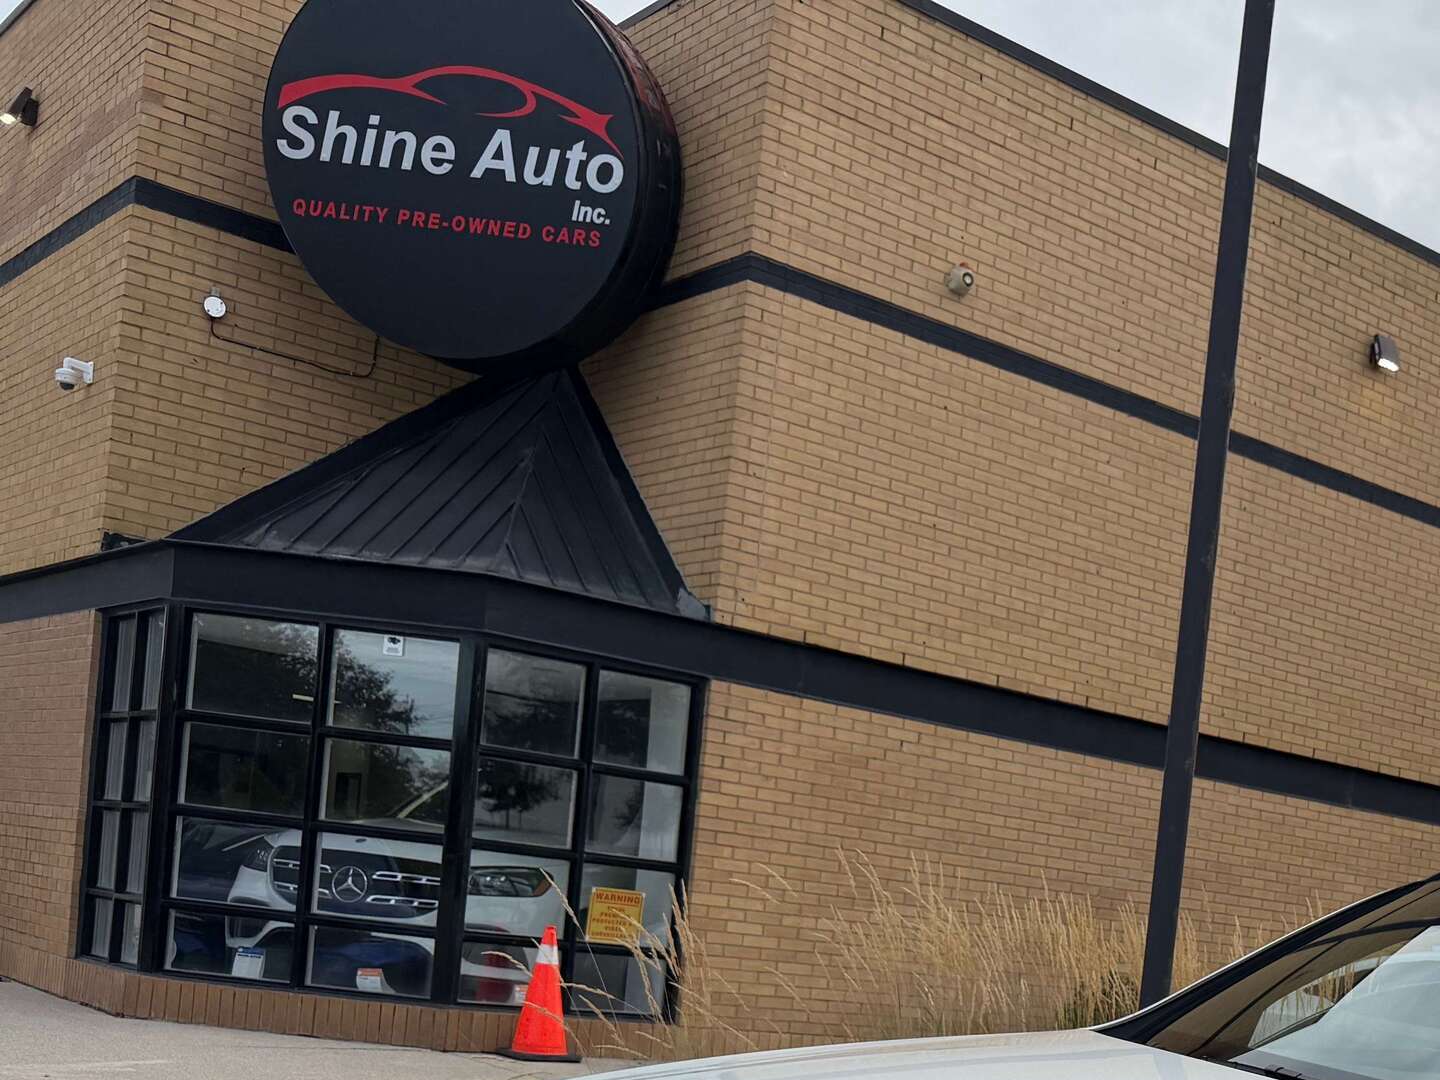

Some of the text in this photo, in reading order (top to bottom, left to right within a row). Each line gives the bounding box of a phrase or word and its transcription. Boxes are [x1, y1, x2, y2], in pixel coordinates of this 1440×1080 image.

[277, 105, 624, 193] Shine Auto
[293, 199, 601, 248] QUALITY PRE-OWNED CARS
[571, 200, 611, 225] Inc.
[596, 892, 640, 905] WARNING
